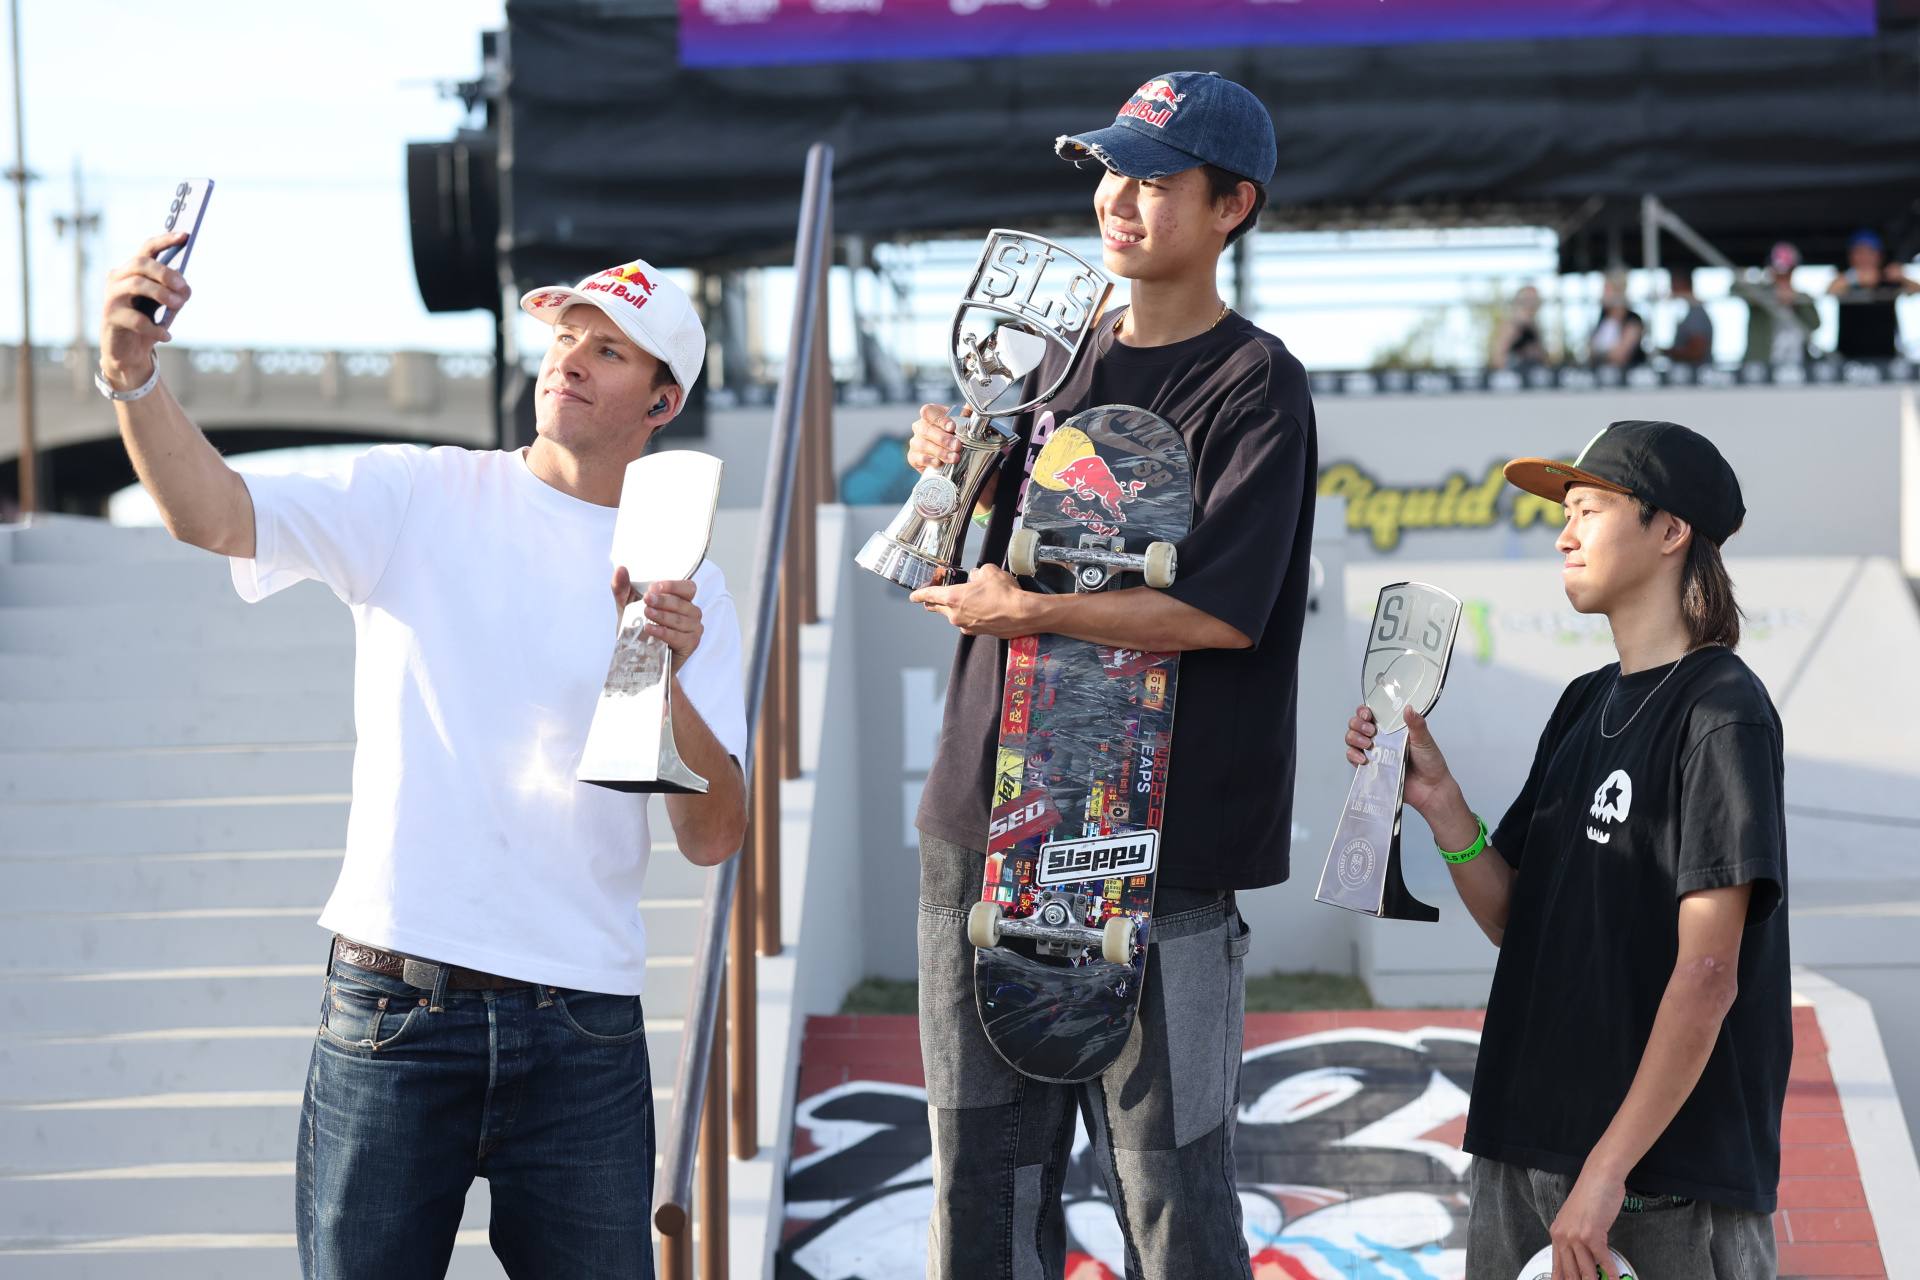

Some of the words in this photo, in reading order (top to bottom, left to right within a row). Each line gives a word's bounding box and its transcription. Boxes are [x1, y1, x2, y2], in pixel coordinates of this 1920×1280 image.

[1136, 101, 1173, 129] Bull
[582, 281, 616, 292] Red
[611, 284, 648, 309] Bull
[980, 242, 1098, 333] SLS
[1377, 595, 1443, 651] SLS
[1136, 729, 1157, 794] HEAPS
[1460, 849, 1476, 860] Pro
